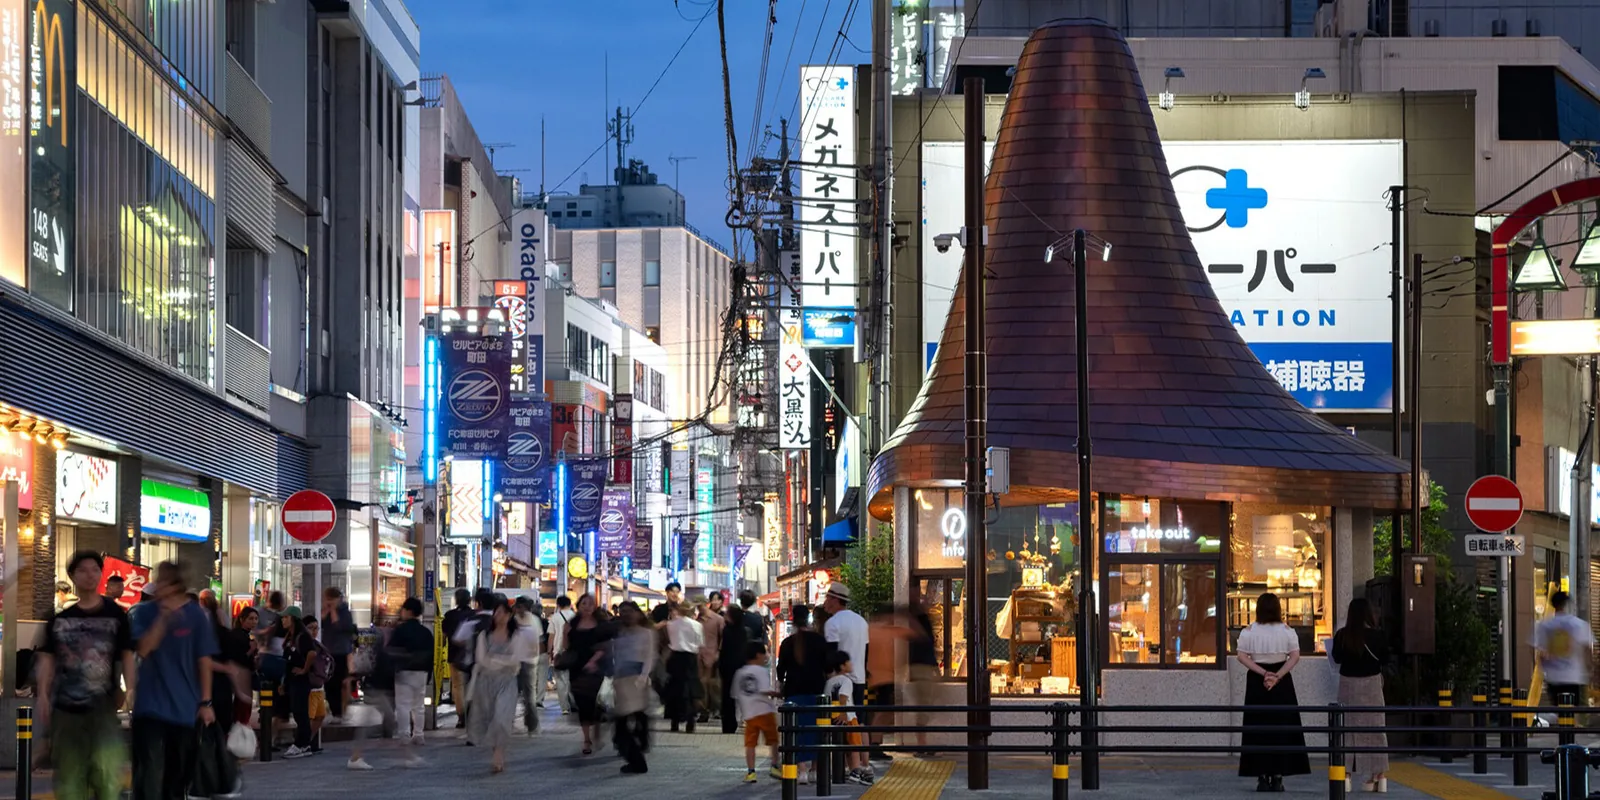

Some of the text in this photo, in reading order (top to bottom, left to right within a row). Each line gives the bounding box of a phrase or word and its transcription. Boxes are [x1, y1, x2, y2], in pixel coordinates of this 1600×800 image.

[815, 117, 842, 296] メガネスーパー
[33, 207, 48, 239] 148
[33, 240, 48, 262] SEATS
[502, 283, 519, 294] 5F
[466, 351, 487, 364] 町田
[1265, 359, 1366, 391] 補聴器
[782, 375, 811, 445] 大黒さん
[1131, 522, 1190, 539] take out
[942, 540, 965, 557] info
[1468, 538, 1522, 553] 自転車を除く
[283, 548, 336, 561] 自転車を除く
